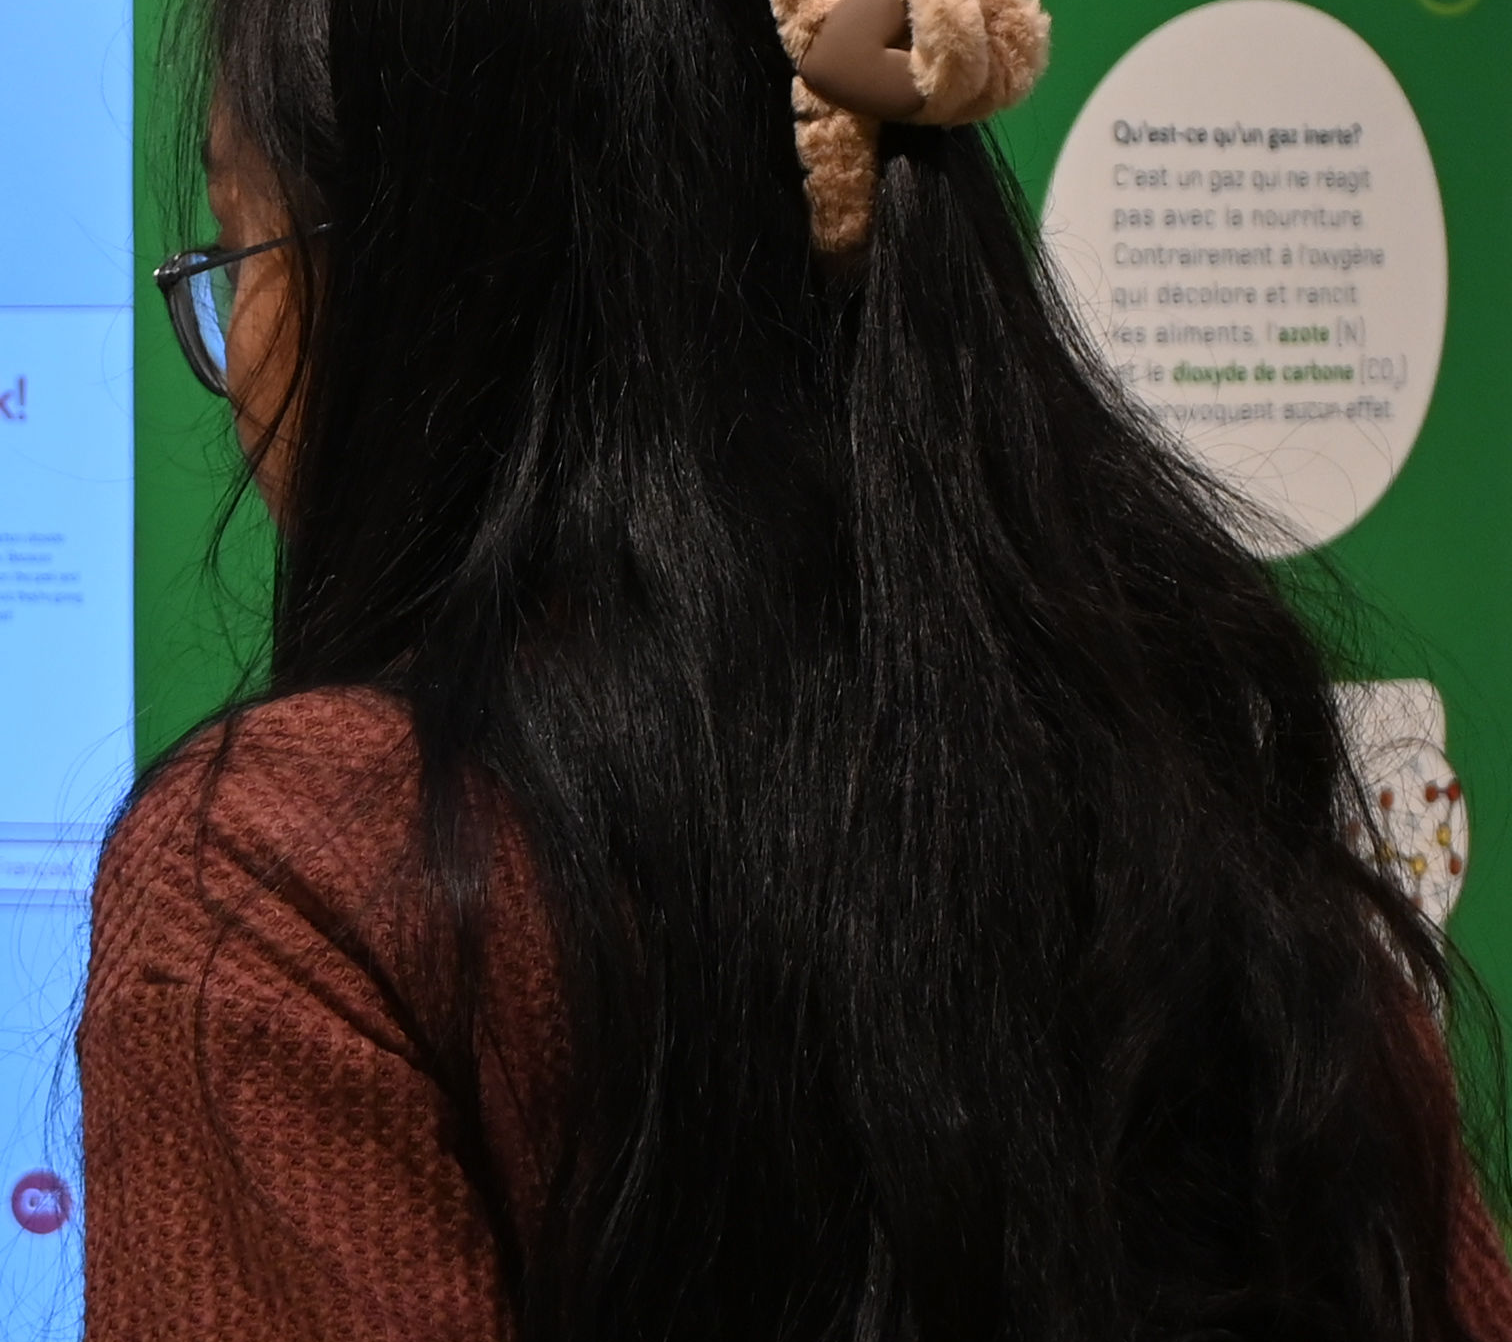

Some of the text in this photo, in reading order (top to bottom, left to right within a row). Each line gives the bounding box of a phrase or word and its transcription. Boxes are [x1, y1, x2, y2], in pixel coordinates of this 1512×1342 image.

[1113, 119, 1208, 145] Qu'est-ce
[1213, 120, 1264, 148] qu'un
[1268, 127, 1298, 150] gaz
[1114, 163, 1168, 188] C'est
[1179, 169, 1203, 188] un
[1210, 170, 1245, 194] gaz
[1252, 169, 1280, 192] qui
[1287, 170, 1309, 188] ne
[1114, 209, 1154, 231] pas
[1165, 208, 1215, 227] avec
[1226, 206, 1243, 227] la
[1114, 242, 1273, 266] Contrairement
[1281, 243, 1293, 266] à
[1114, 286, 1147, 308] qui
[1266, 285, 1286, 305] et
[1296, 285, 1357, 305] rancit
[1172, 360, 1248, 386] dioxyde
[1253, 358, 1276, 382] de
[1282, 359, 1355, 382] carbone
